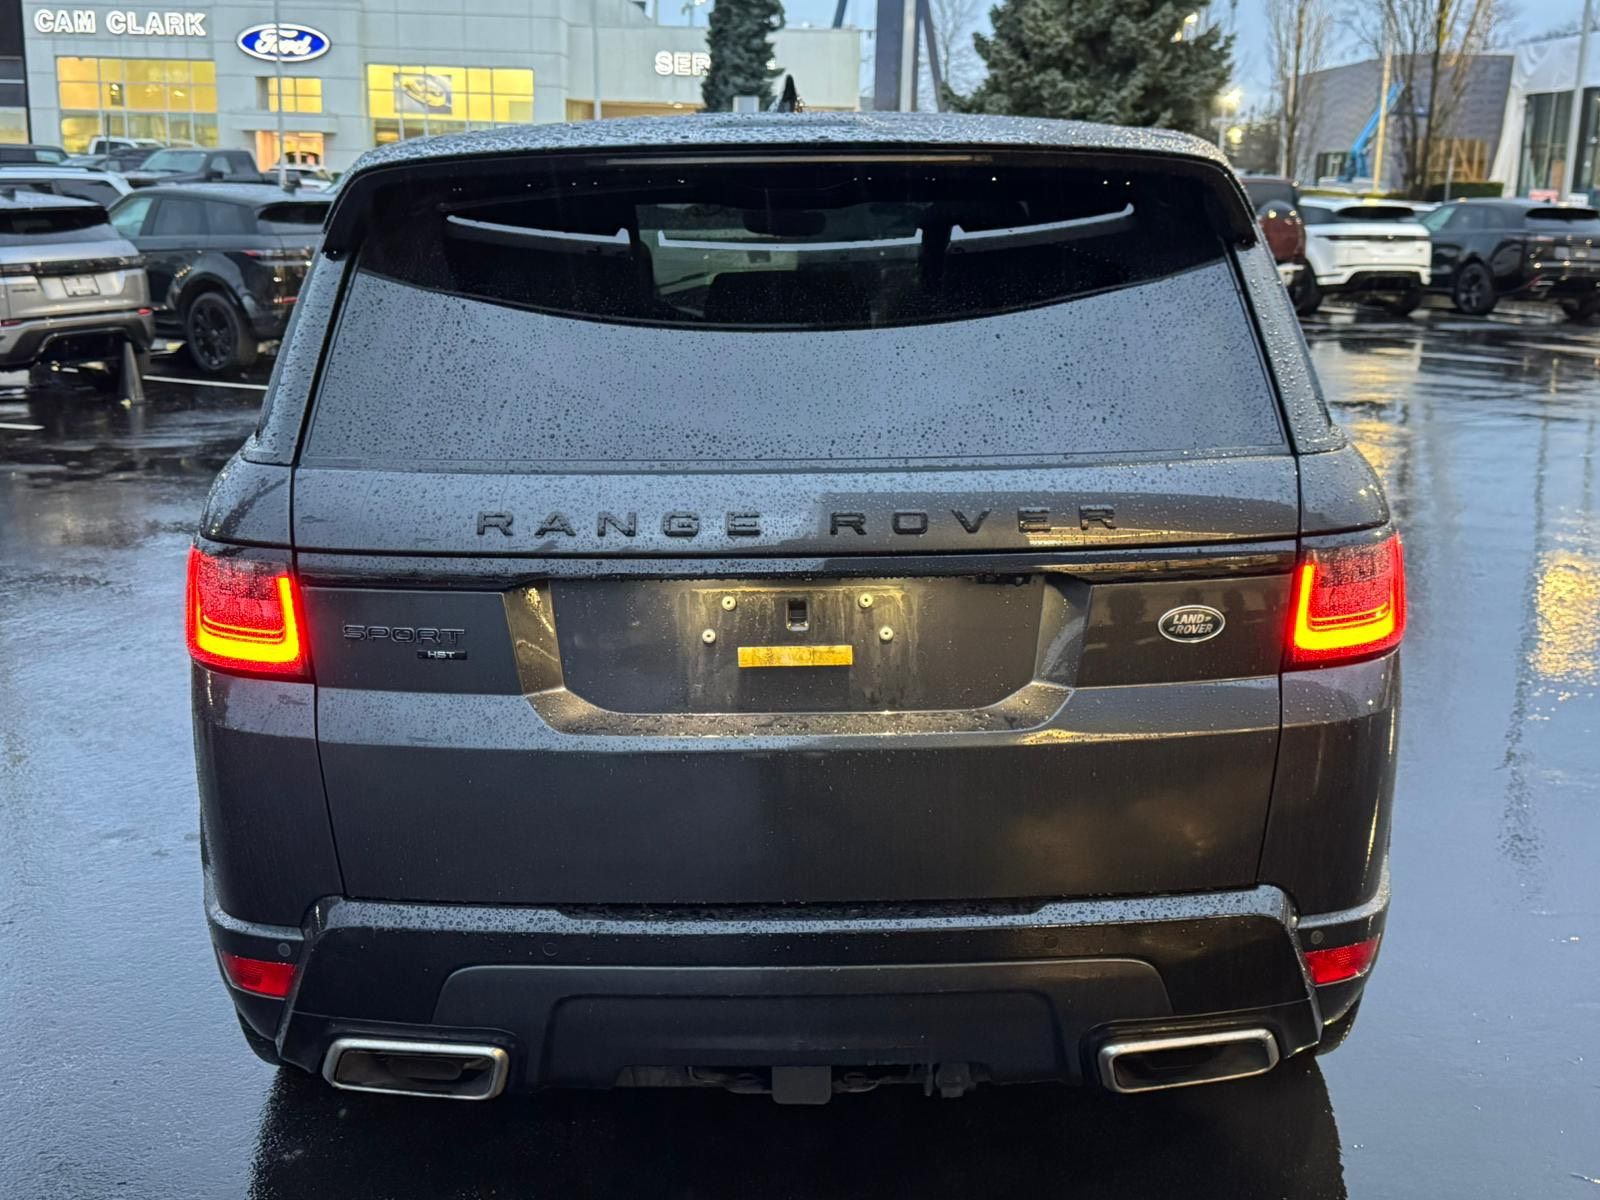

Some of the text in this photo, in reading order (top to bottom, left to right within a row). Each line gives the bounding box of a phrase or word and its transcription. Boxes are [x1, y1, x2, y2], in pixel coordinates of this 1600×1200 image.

[34, 9, 206, 36] CAM CLARK
[254, 29, 312, 55] Ford
[476, 504, 1118, 537] RANGE ROVER
[1173, 614, 1204, 624] LAND
[343, 624, 465, 643] SPORT
[1175, 624, 1213, 634] ROVER
[427, 650, 456, 659] HST
